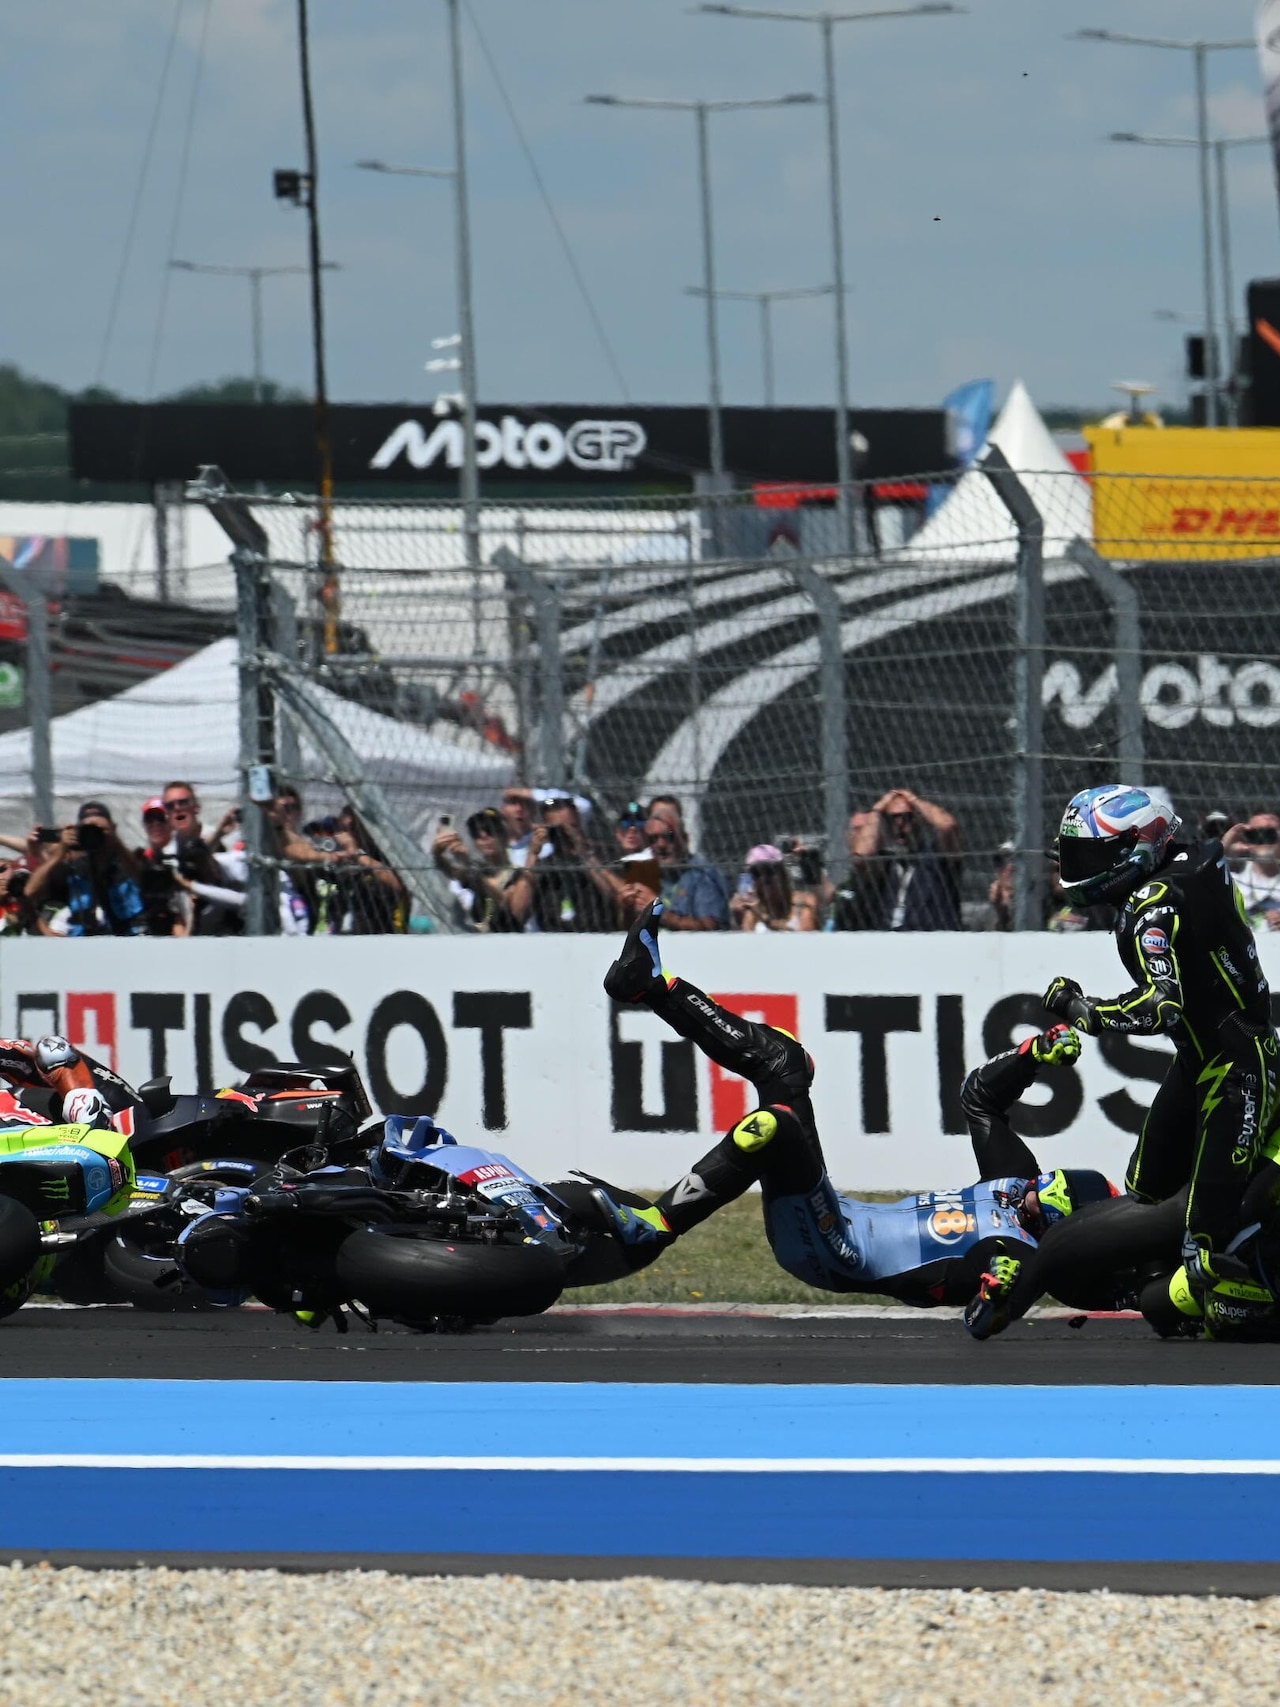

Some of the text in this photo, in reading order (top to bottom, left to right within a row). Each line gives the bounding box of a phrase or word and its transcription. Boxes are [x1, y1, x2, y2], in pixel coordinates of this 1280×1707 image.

[369, 416, 647, 471] MotoGP
[686, 993, 746, 1040] DAINESE
[1237, 1073, 1257, 1146] SuperFile
